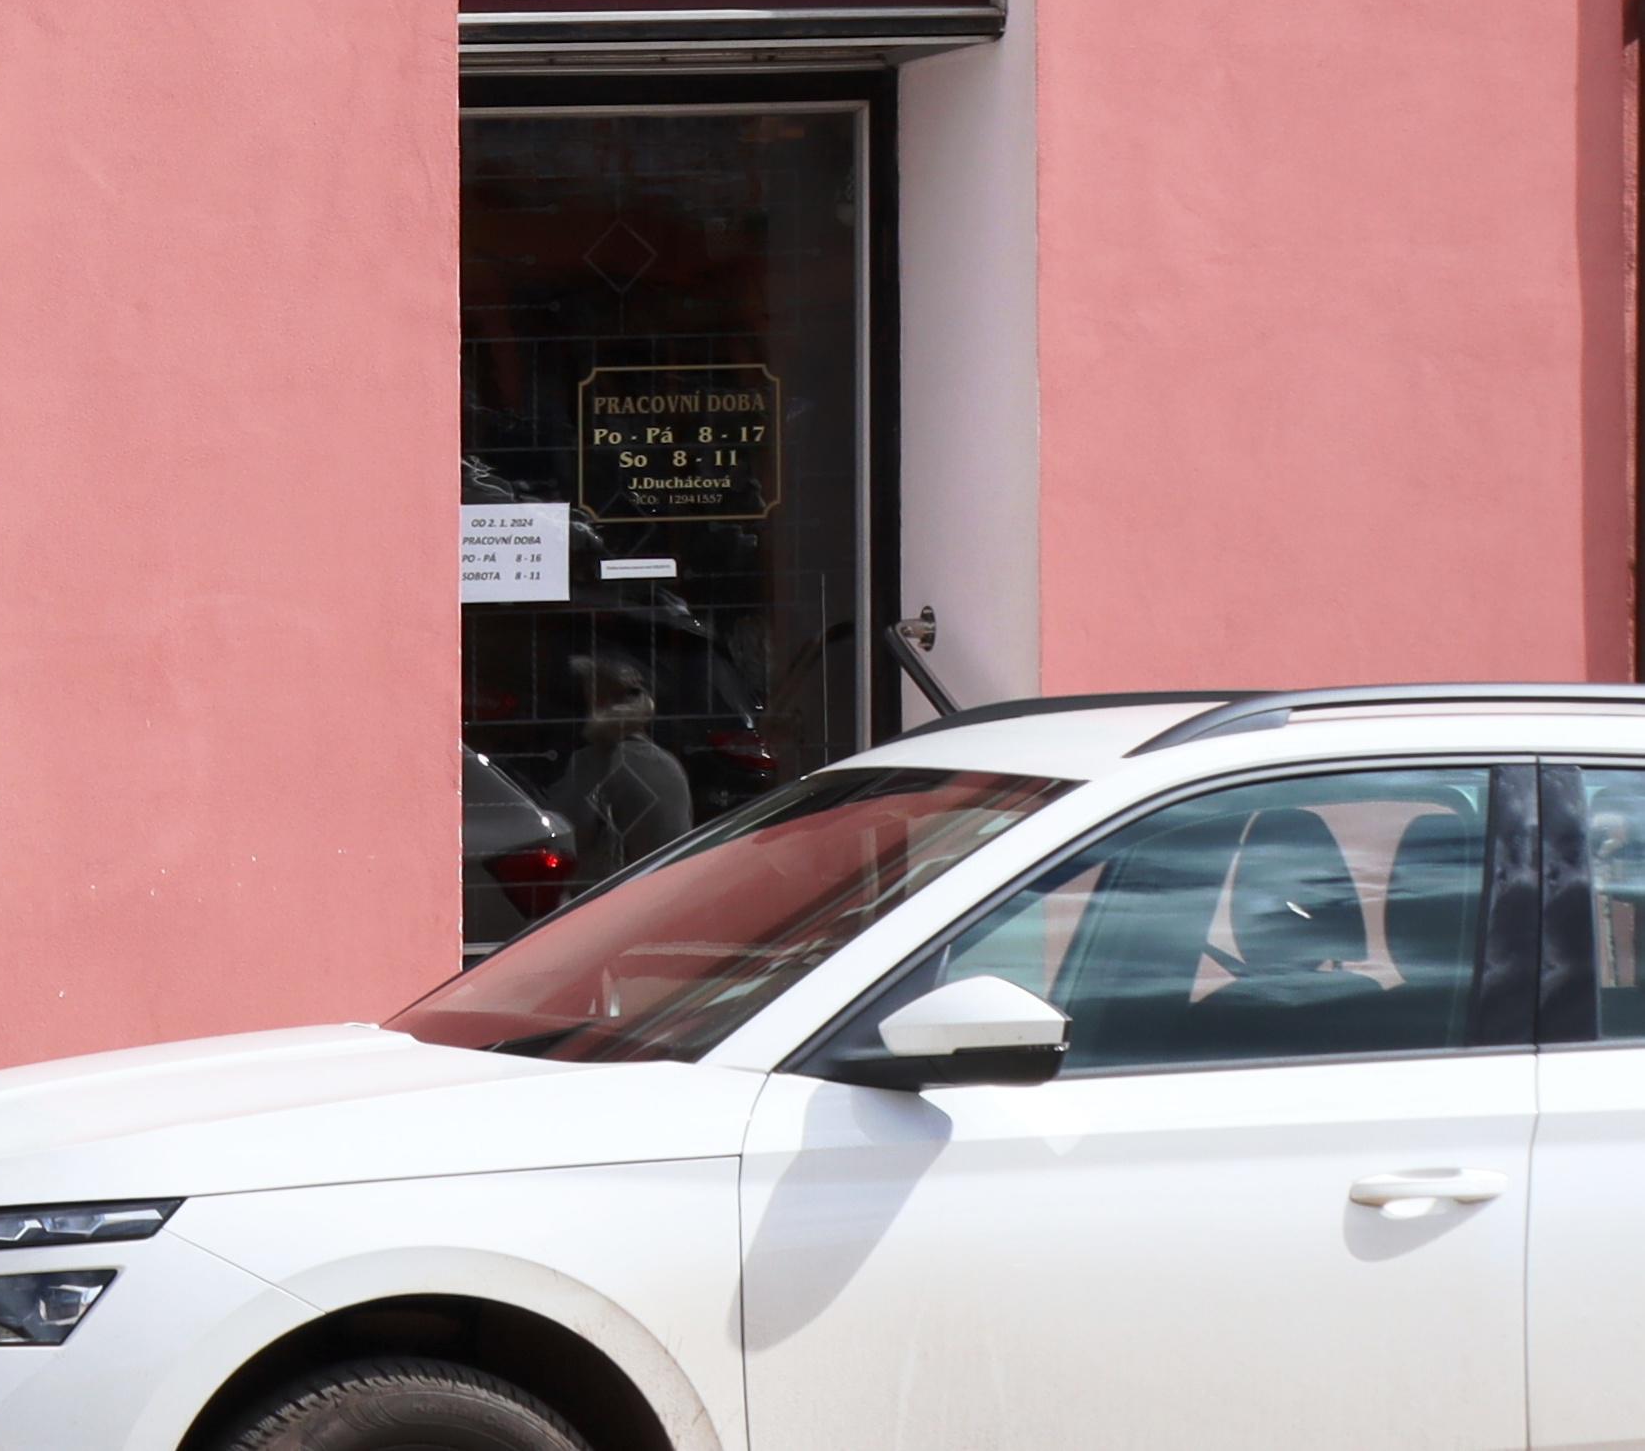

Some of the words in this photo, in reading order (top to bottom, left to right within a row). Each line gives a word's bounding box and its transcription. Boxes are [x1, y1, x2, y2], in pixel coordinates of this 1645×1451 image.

[593, 390, 700, 415] PRACOVNÍ
[707, 392, 765, 413] DOBA
[593, 428, 623, 446] Po
[645, 425, 674, 445] Pá
[697, 426, 714, 444] 8
[739, 425, 765, 443] 17
[618, 450, 649, 469] So
[672, 449, 689, 468] 8
[714, 449, 738, 467] 11
[471, 518, 487, 528] OD
[510, 518, 534, 528] 2024
[462, 534, 512, 546] PRACOVNÍ
[513, 535, 542, 545] DOBA
[461, 554, 476, 564] PO
[483, 552, 497, 563] PÁ
[530, 554, 542, 563] 16
[461, 571, 501, 581] SOBOTA
[529, 571, 541, 581] 11
